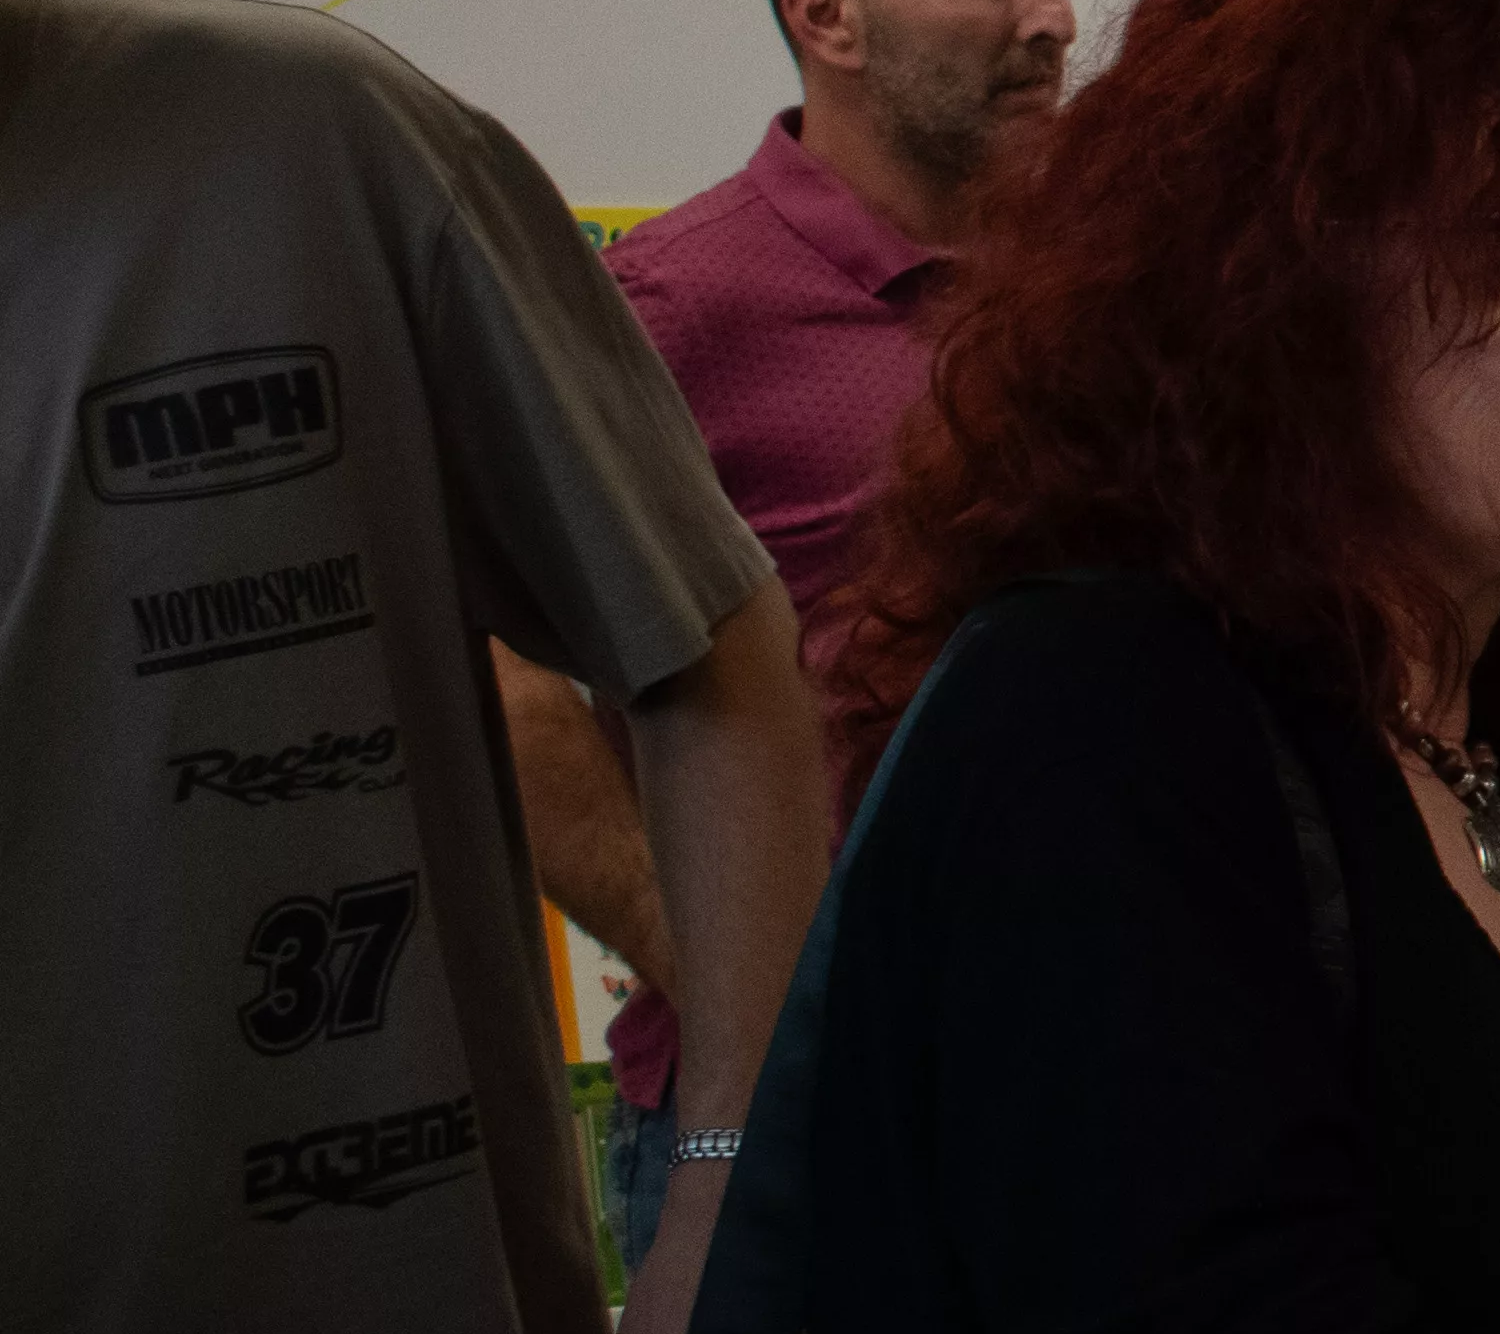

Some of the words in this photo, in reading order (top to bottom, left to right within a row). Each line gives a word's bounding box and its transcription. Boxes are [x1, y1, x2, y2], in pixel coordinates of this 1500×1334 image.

[107, 367, 327, 469] MPH
[131, 552, 367, 654] MOTORSPORT
[167, 724, 398, 803] Racing
[238, 870, 419, 1056] 37
